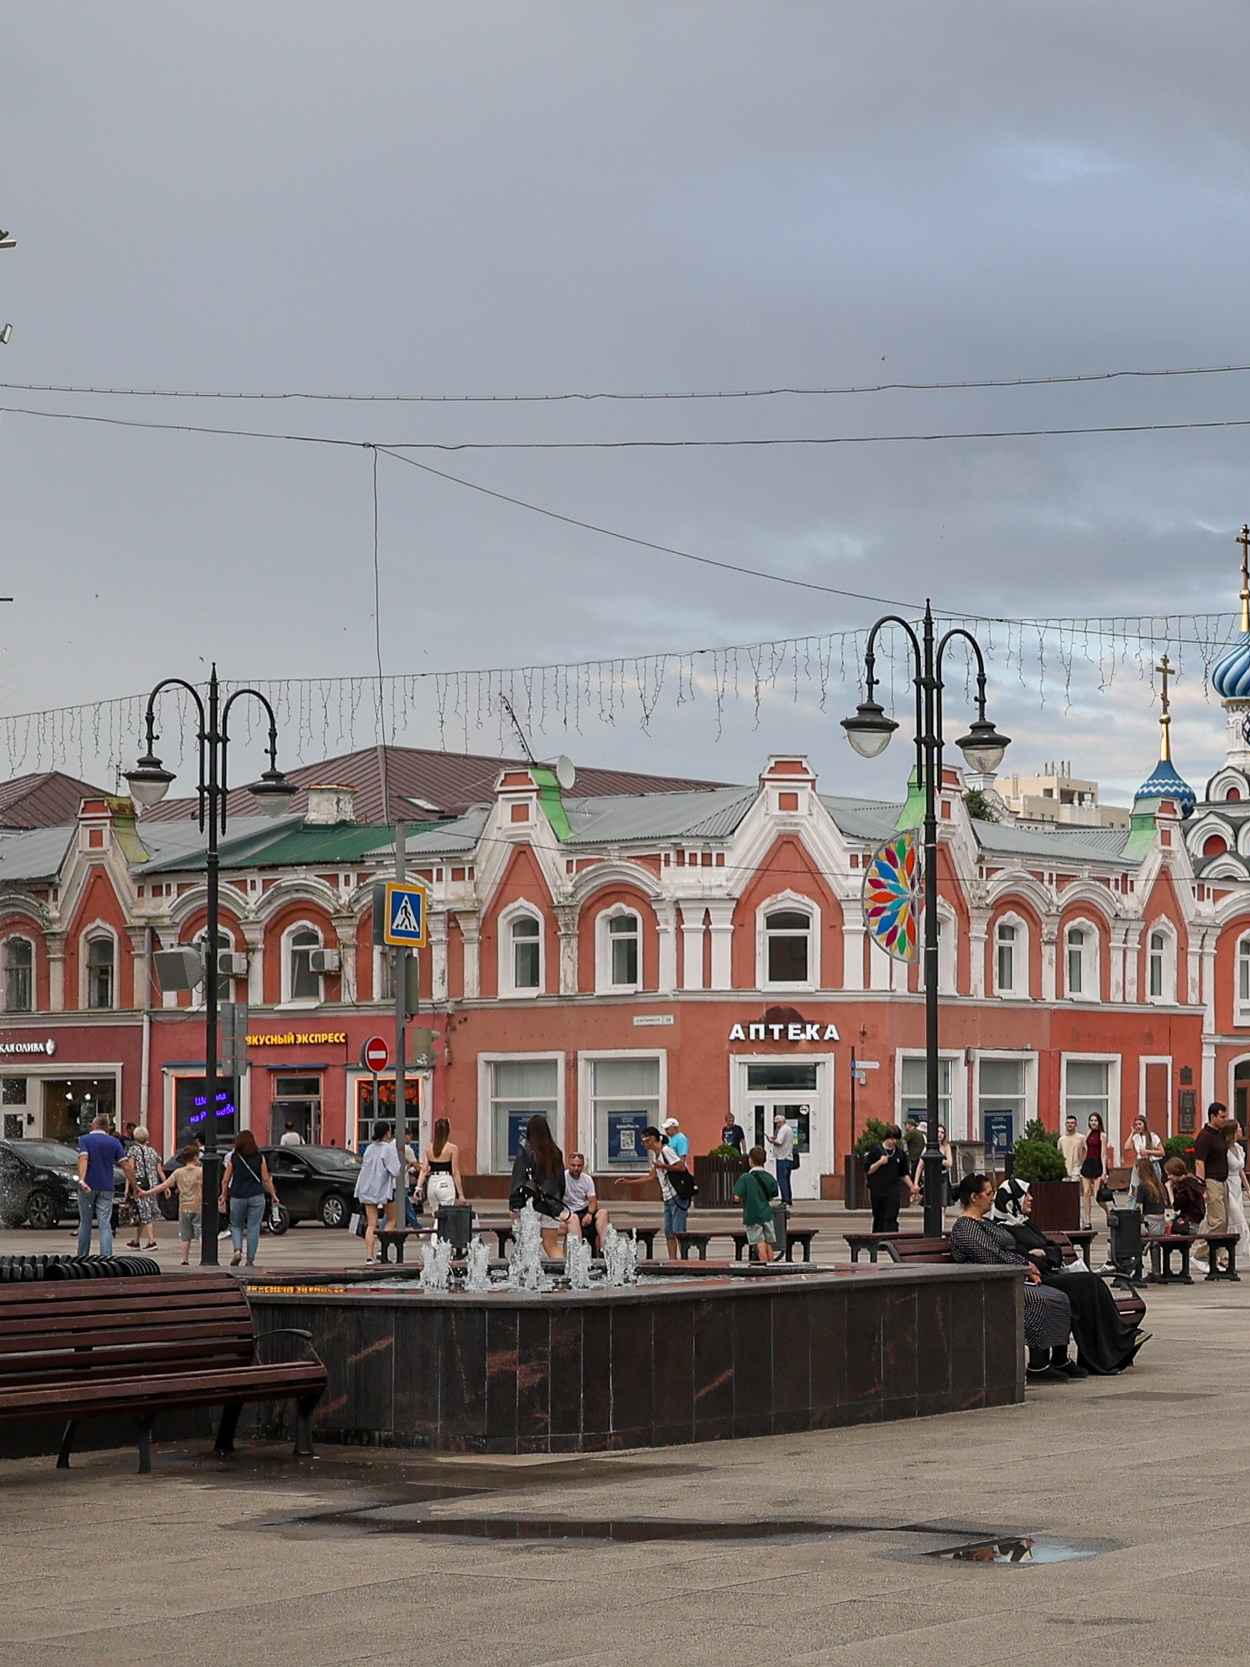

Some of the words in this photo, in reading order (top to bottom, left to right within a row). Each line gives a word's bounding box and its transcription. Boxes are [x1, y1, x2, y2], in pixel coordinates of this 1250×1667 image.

[295, 1032, 346, 1044] ЭКСПРЕСС
[728, 1023, 840, 1041] АПТЕКА
[15, 1043, 45, 1053] ОЛИВА
